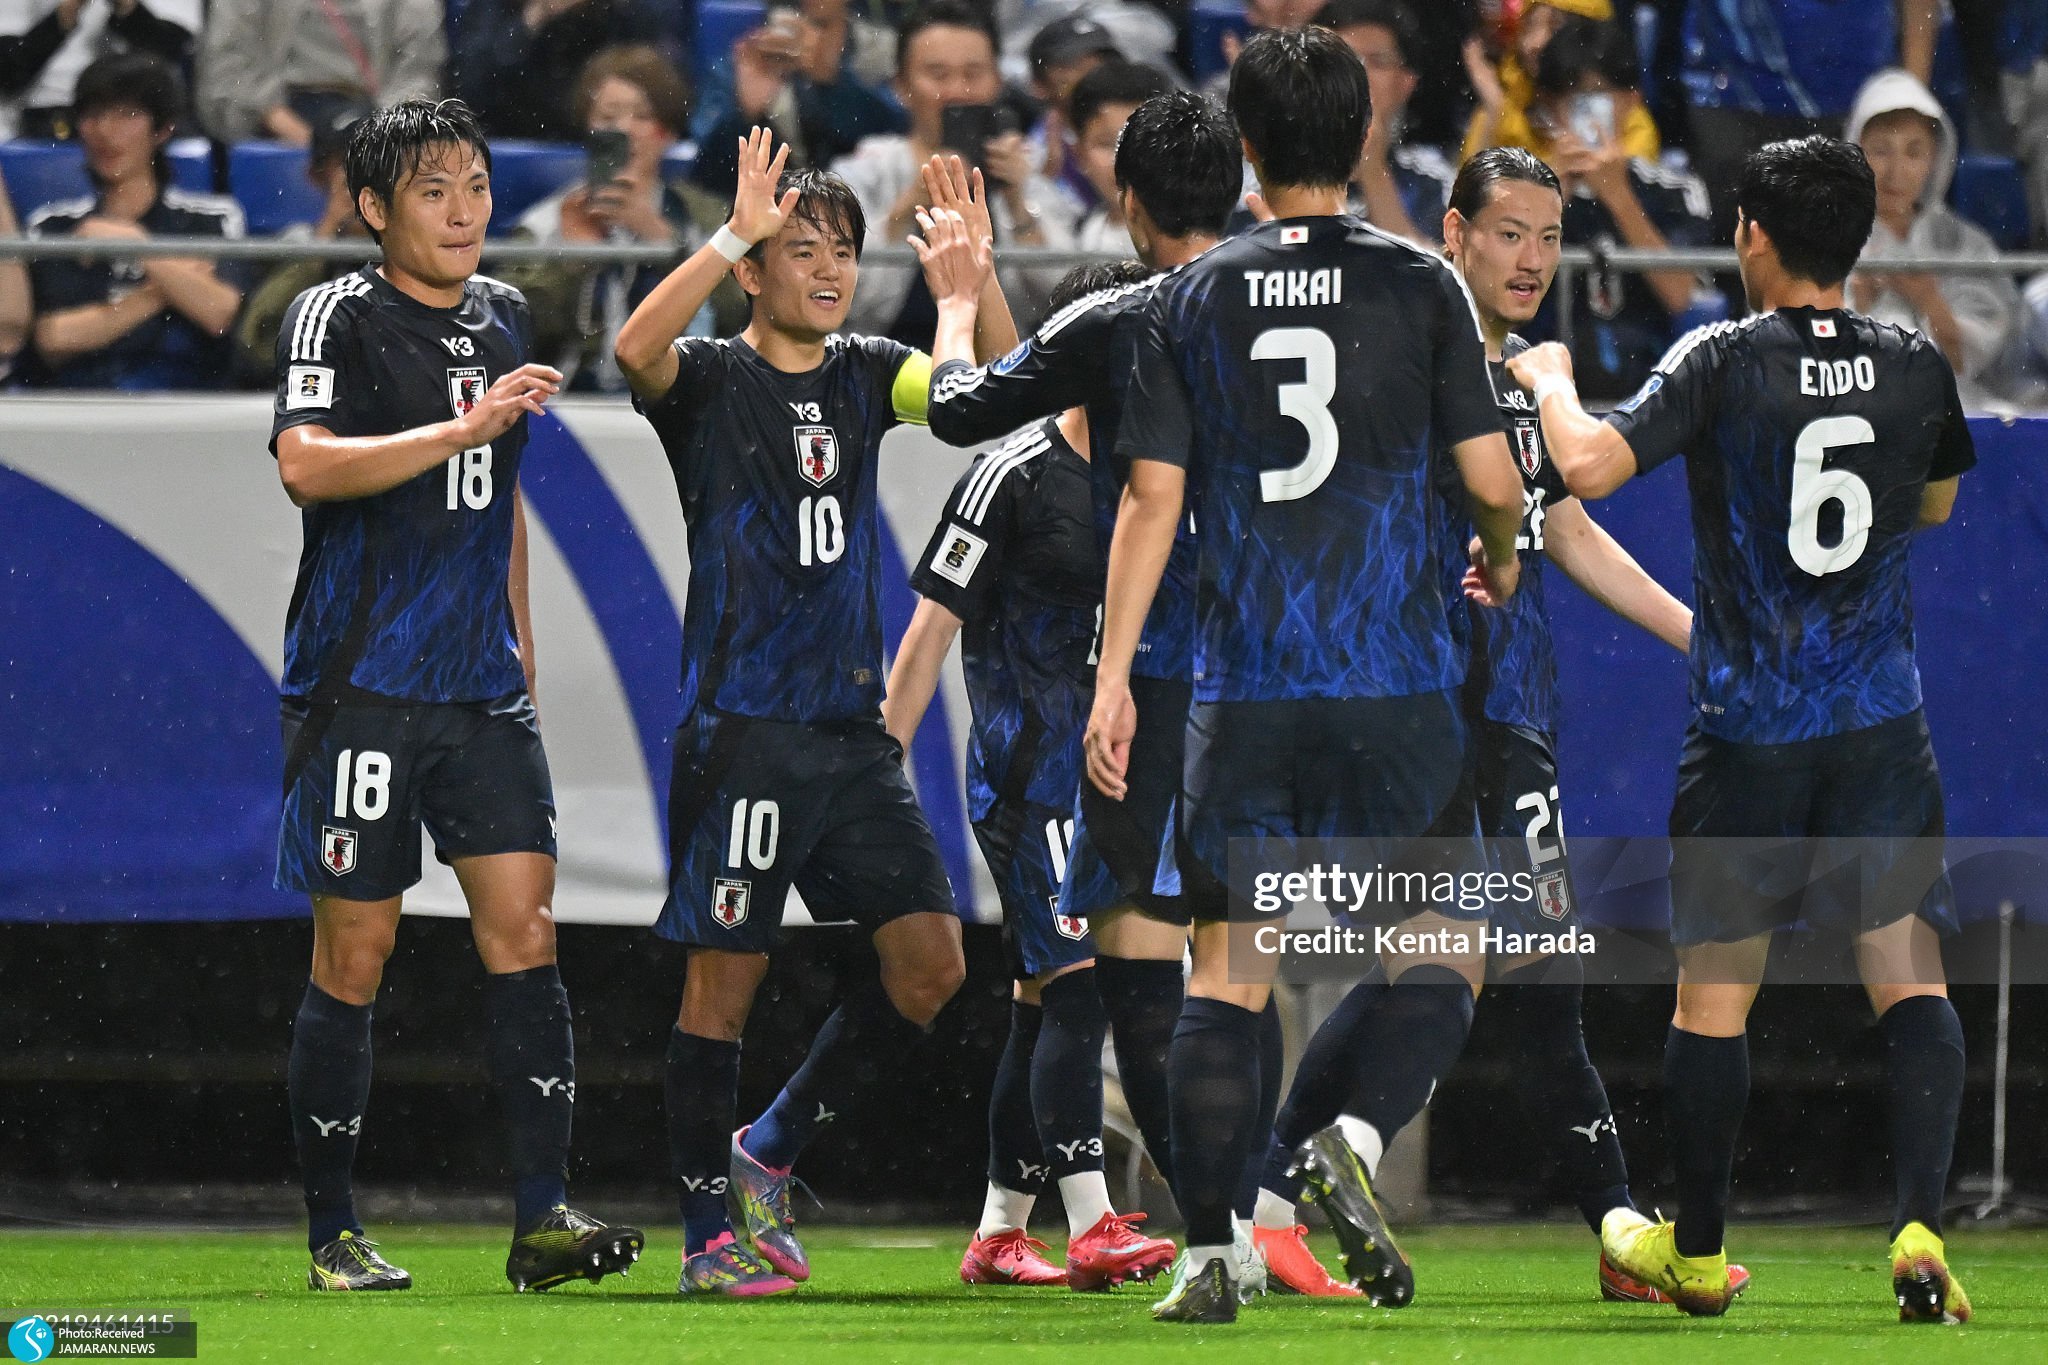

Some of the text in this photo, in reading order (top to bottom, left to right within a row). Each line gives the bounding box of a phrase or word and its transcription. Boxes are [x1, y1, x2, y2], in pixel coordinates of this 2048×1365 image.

[1244, 267, 1342, 307] TAKAI
[440, 336, 475, 357] Y-3
[1800, 356, 1876, 397] ENDO
[788, 401, 823, 423] Y-3
[1250, 326, 1340, 503] 3
[447, 443, 493, 511] 18
[1787, 415, 1876, 578] 6
[798, 495, 845, 567] 10
[334, 749, 392, 821] 18
[728, 798, 780, 871] 10
[310, 1114, 362, 1137] Y-3
[1056, 1137, 1103, 1162] Y-3
[681, 1175, 730, 1195] Y-3
